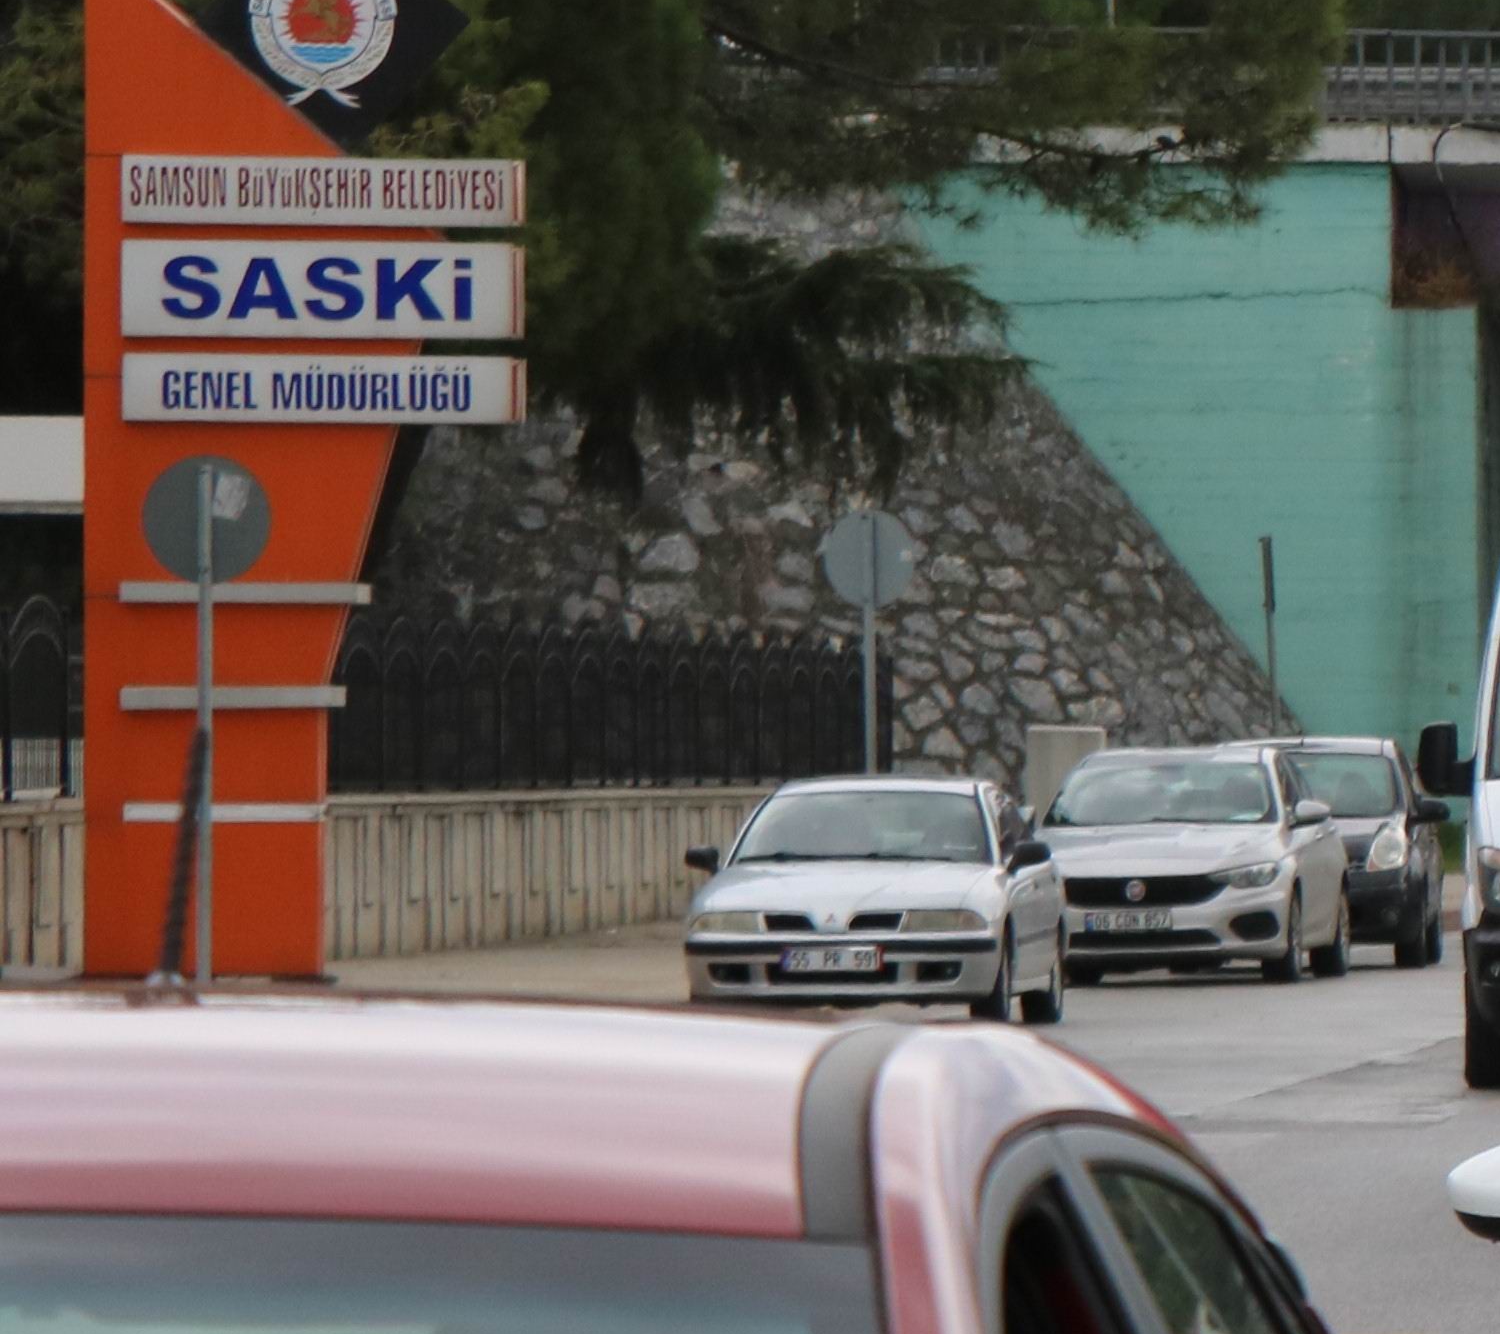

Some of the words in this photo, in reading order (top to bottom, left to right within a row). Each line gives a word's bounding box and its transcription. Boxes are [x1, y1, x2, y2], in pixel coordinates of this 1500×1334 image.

[130, 165, 227, 207] SAMSUN
[161, 369, 258, 410] GENEL
[271, 366, 472, 412] MÜDÜRLÜĞÜ
